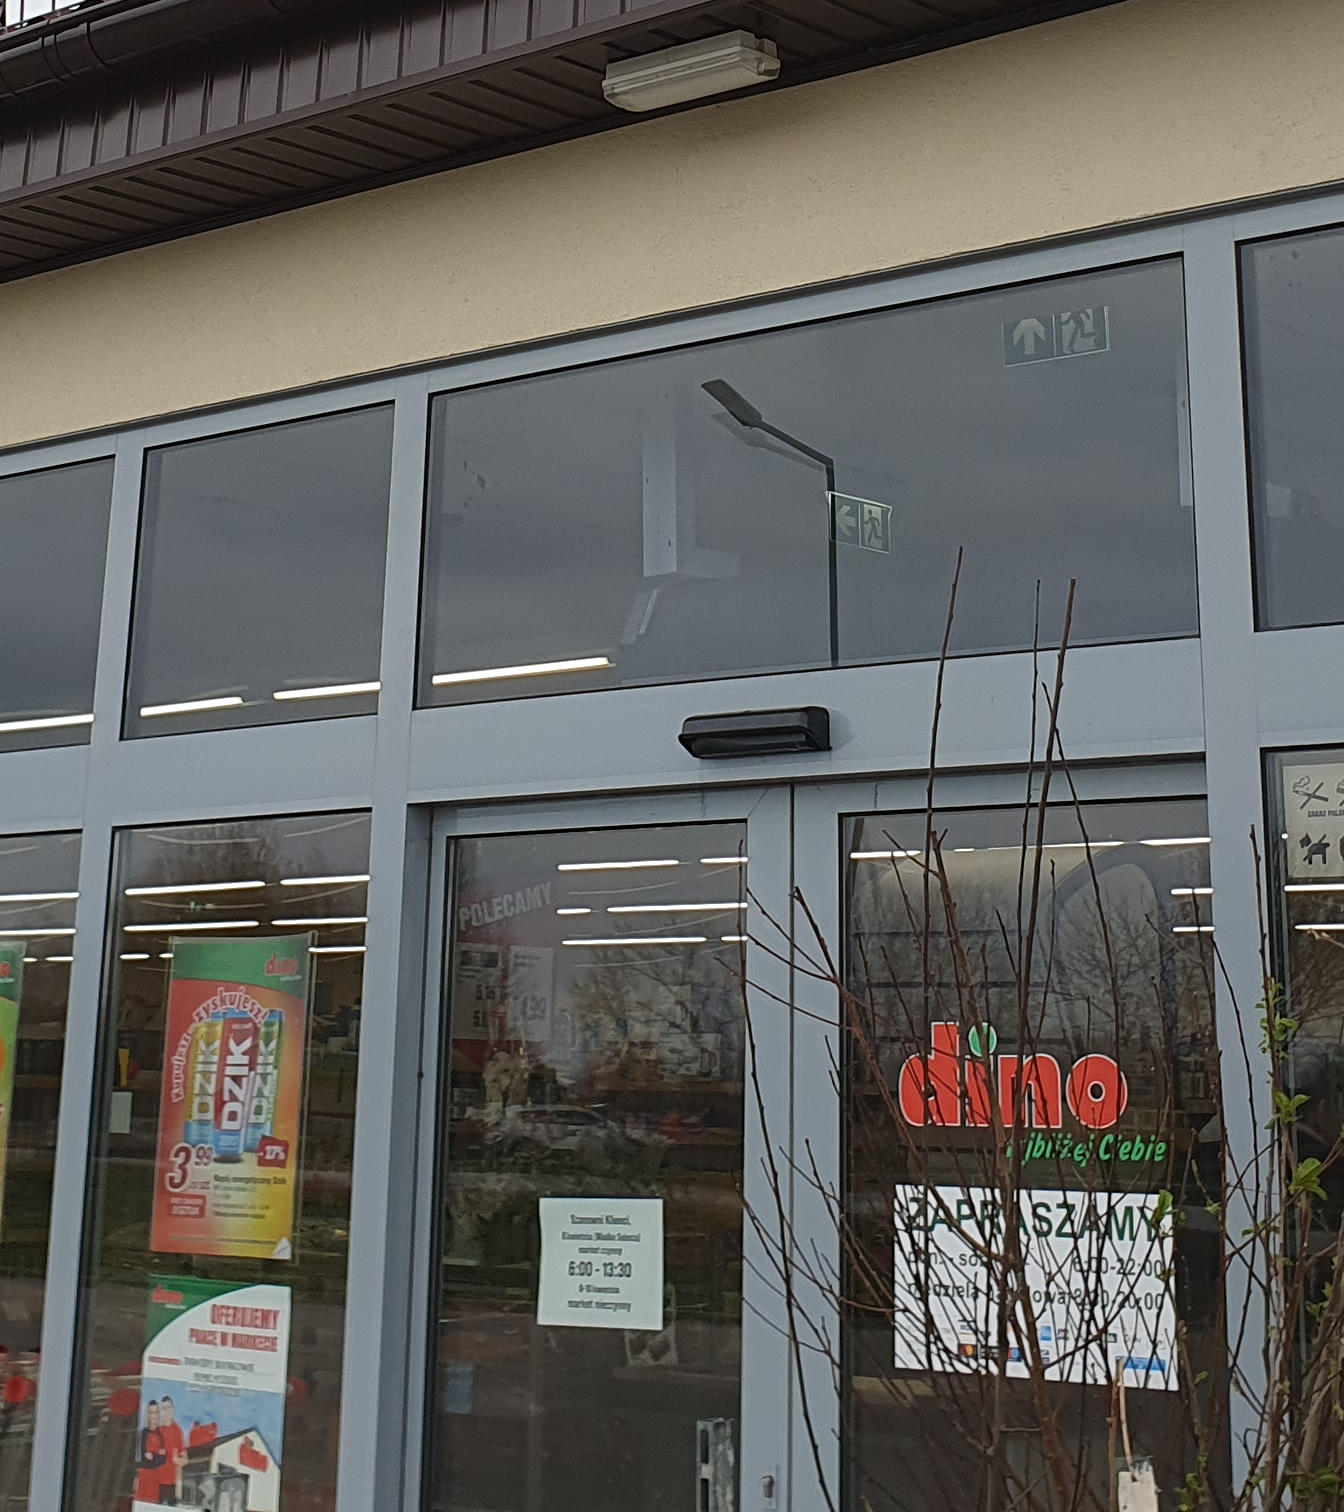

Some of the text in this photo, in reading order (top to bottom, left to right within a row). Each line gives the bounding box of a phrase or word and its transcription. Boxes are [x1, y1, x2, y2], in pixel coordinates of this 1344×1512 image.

[459, 882, 551, 931] POLECAMY
[193, 1039, 220, 1121] DZIK
[221, 1035, 252, 1130] DZIK
[248, 1039, 276, 1123] DZIK
[899, 1021, 1128, 1129] dino
